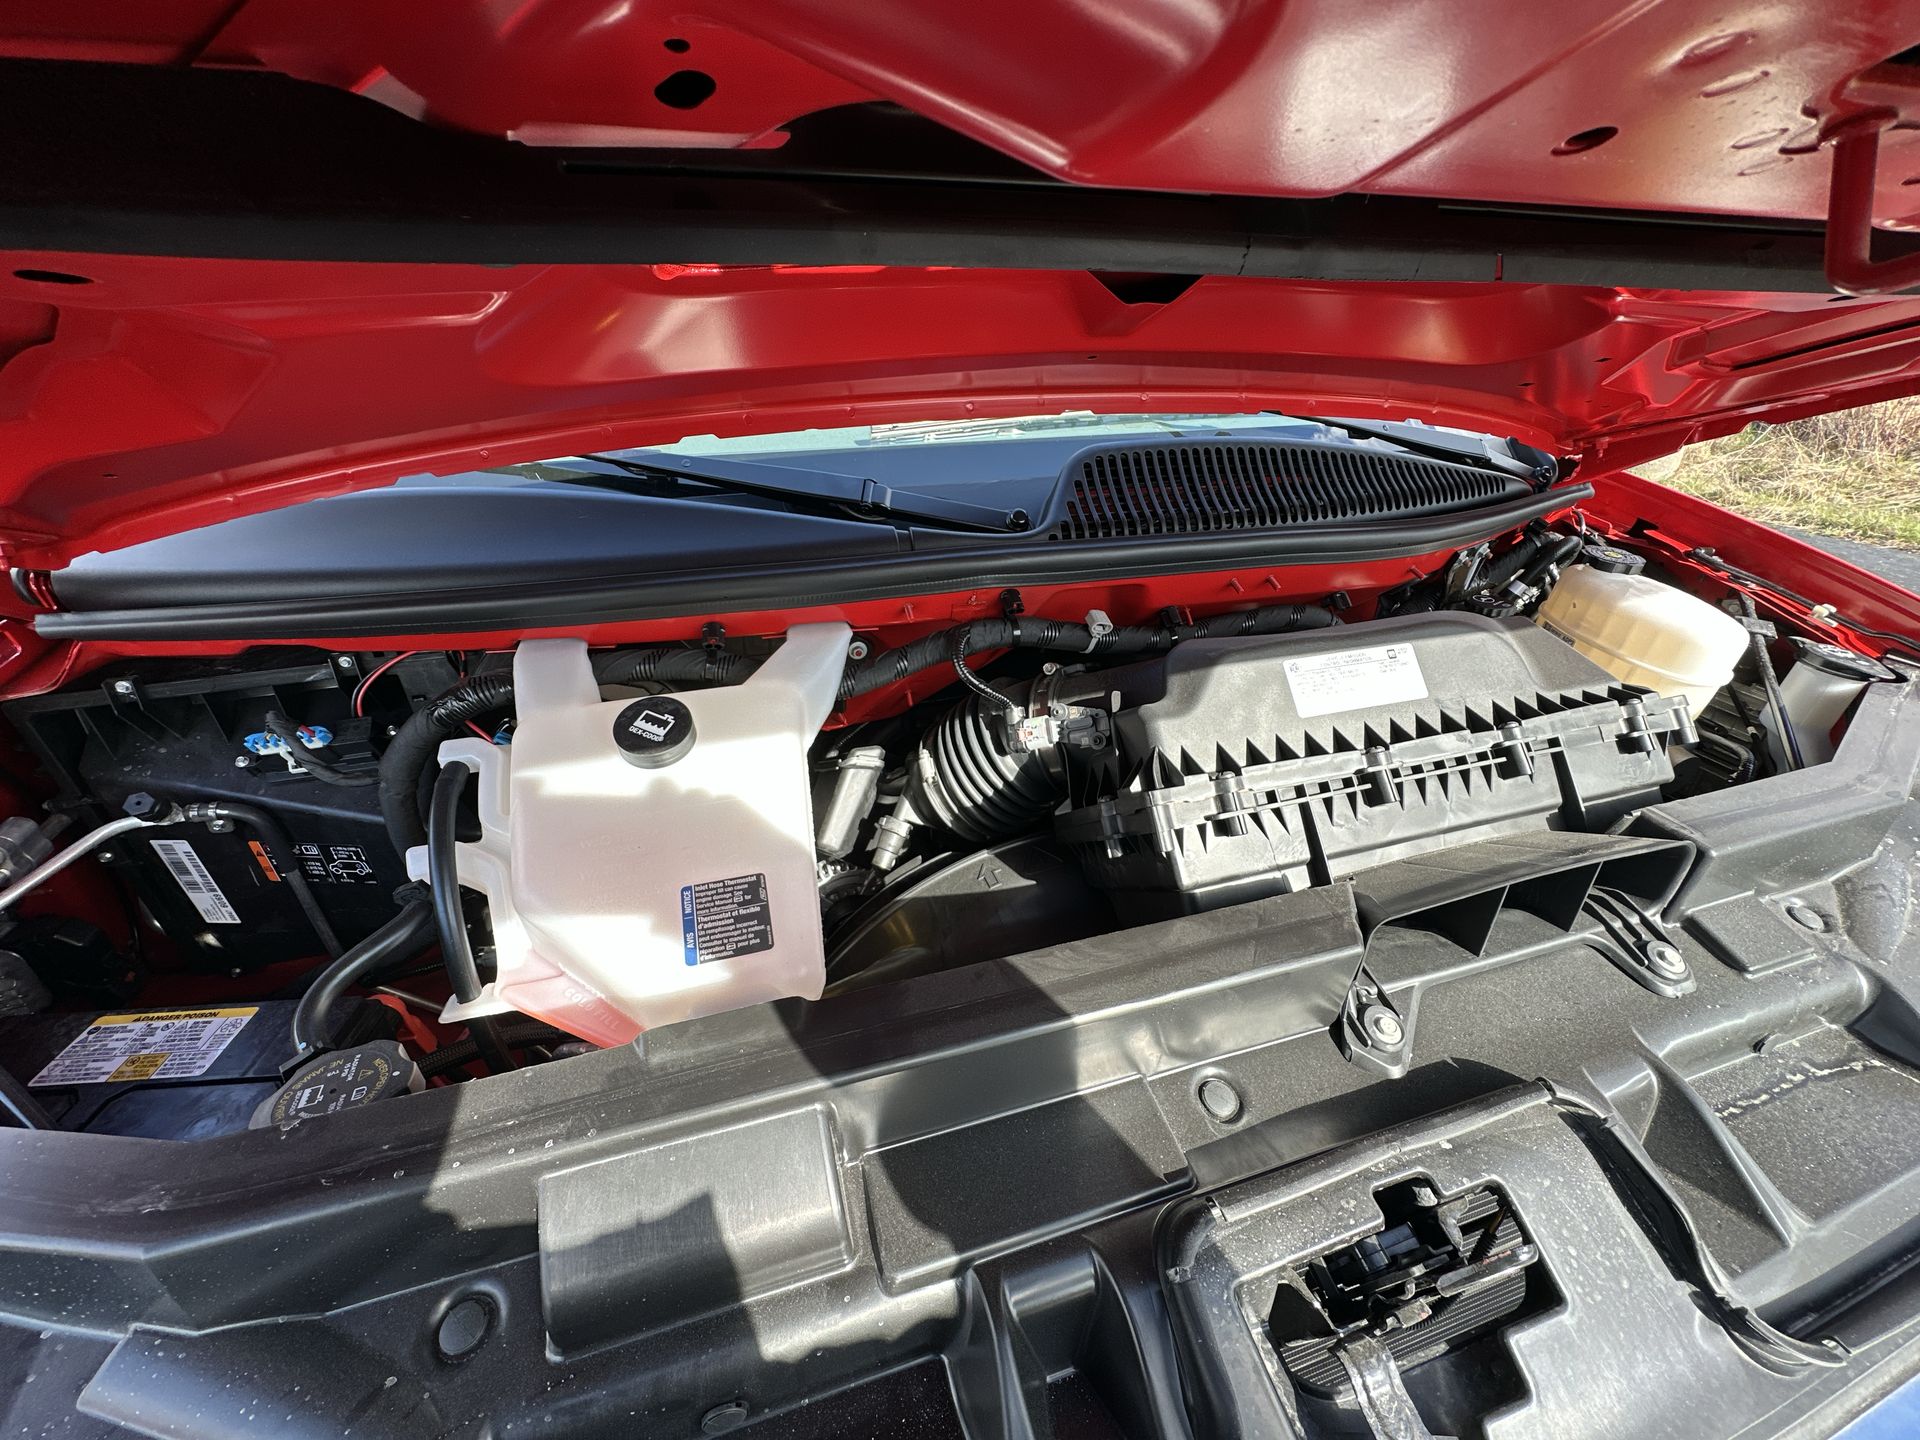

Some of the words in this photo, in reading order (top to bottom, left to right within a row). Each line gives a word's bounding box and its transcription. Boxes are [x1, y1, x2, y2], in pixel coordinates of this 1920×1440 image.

[709, 881, 723, 889] Hose
[724, 875, 756, 886] Thermostat
[698, 912, 731, 922] Thermostat
[739, 906, 760, 915] flexible
[564, 988, 594, 1011] COLD
